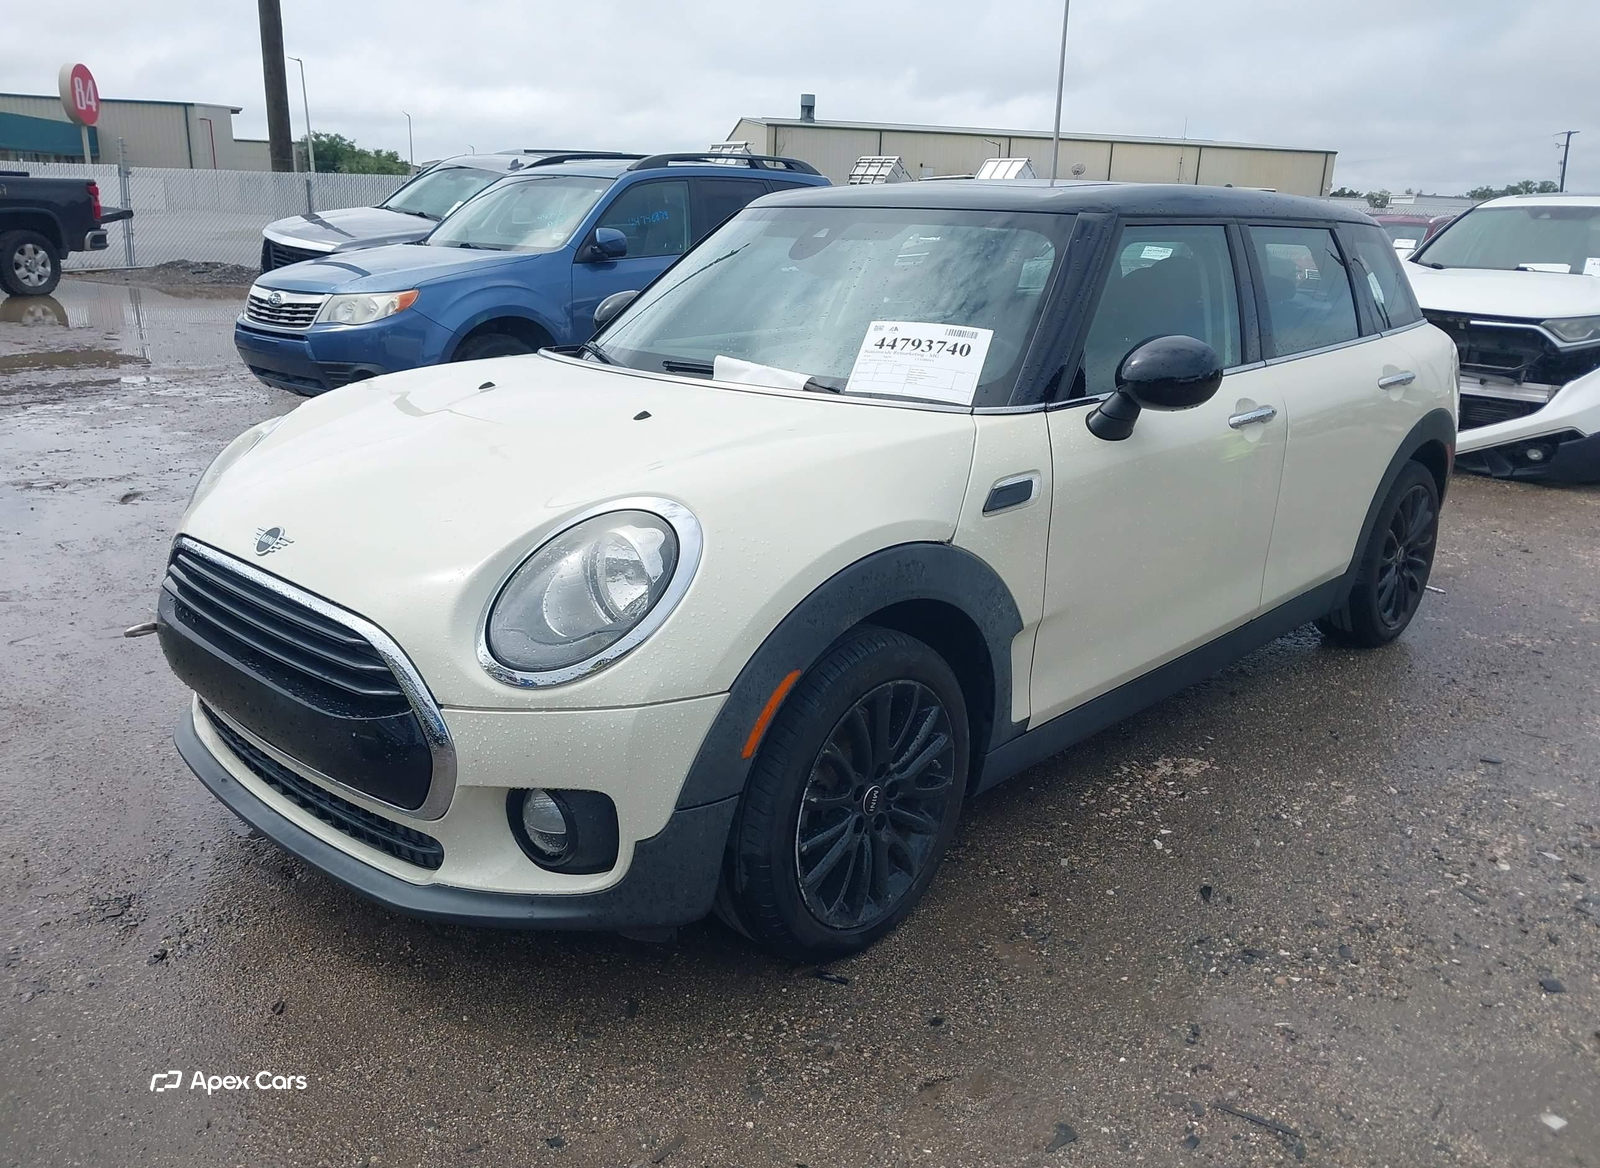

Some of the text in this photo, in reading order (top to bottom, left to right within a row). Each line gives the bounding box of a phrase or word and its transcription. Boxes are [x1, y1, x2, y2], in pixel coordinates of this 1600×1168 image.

[74, 77, 97, 112] 84
[874, 337, 971, 357] 44793740
[869, 790, 879, 812] MINI
